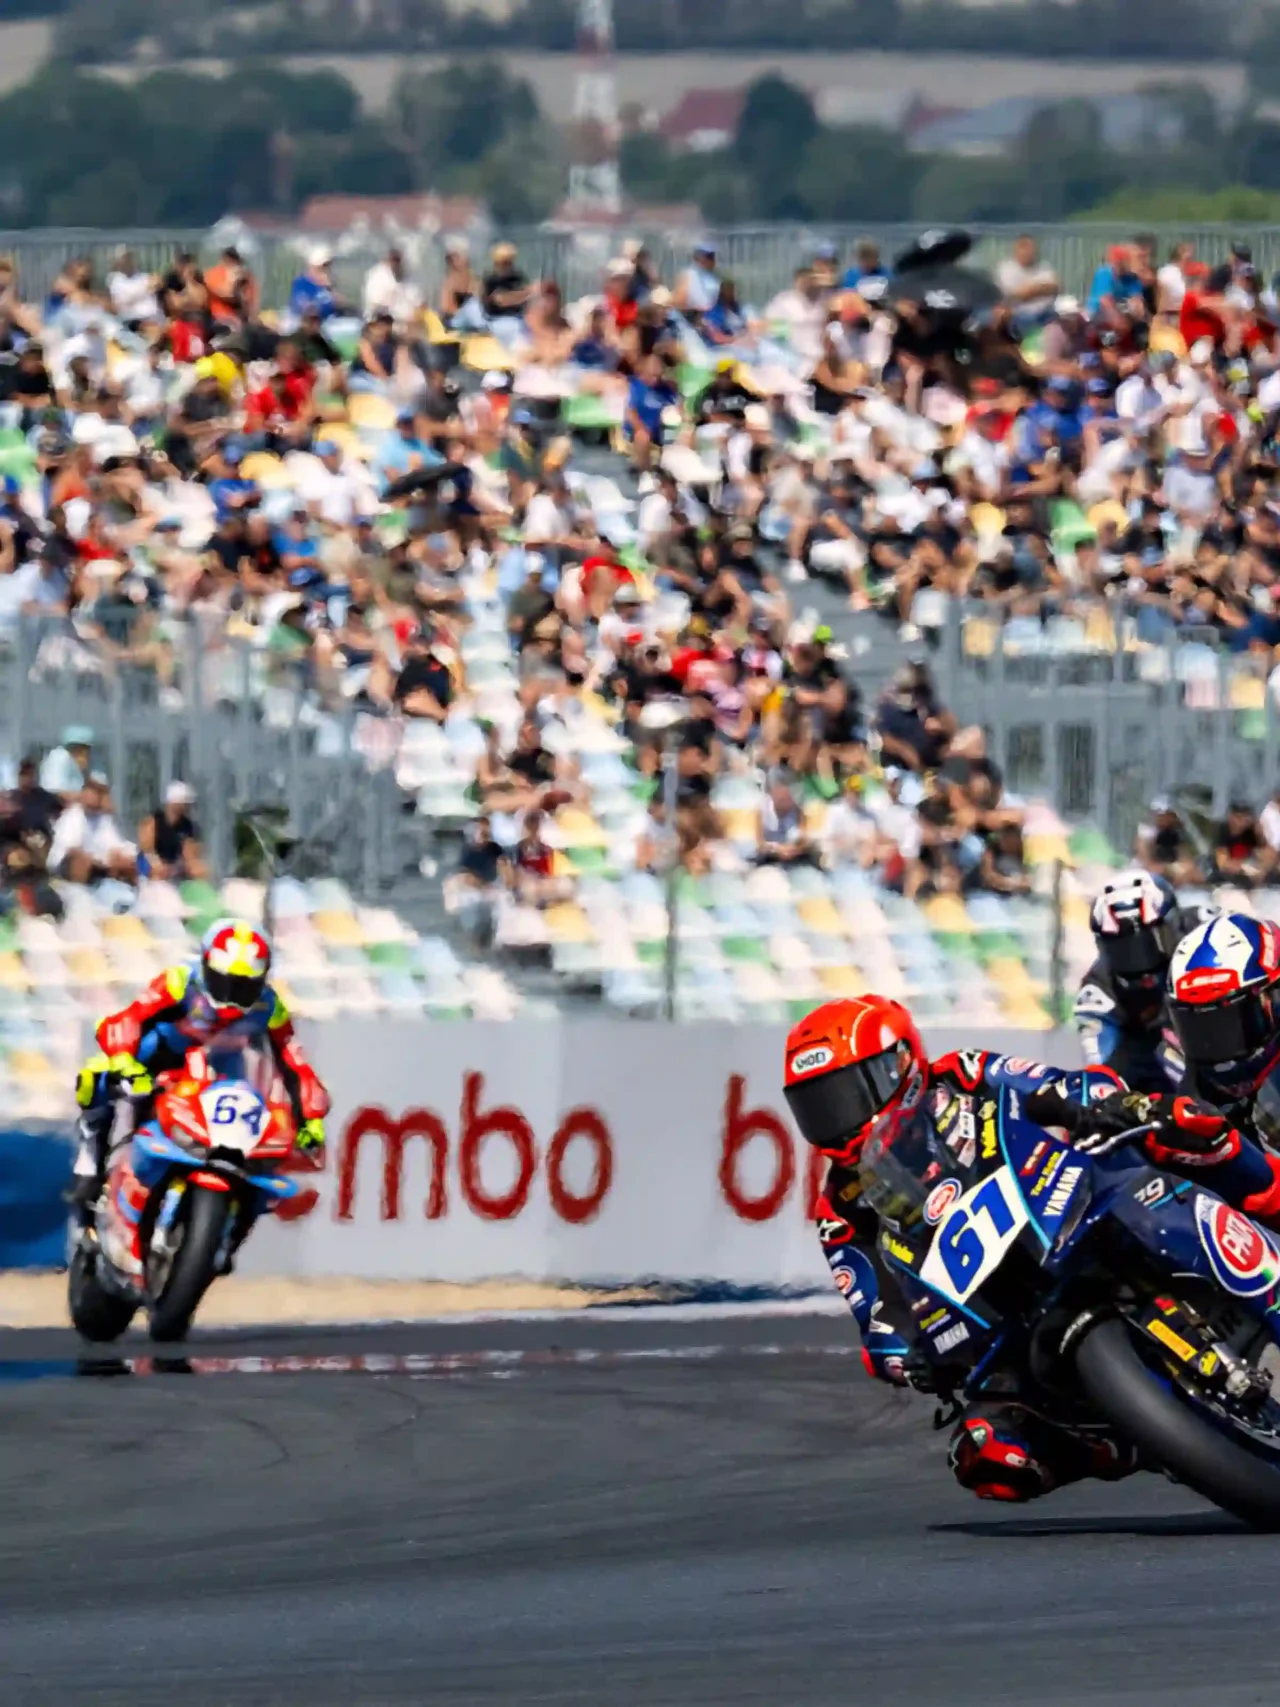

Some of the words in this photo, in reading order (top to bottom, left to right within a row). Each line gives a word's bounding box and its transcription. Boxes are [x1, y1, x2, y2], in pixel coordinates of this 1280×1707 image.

[212, 1094, 263, 1136] 64
[272, 1070, 612, 1225] mbo
[1042, 1166, 1084, 1216] YAMAHA
[938, 1177, 1016, 1295] 61
[1221, 1212, 1255, 1266] PATA
